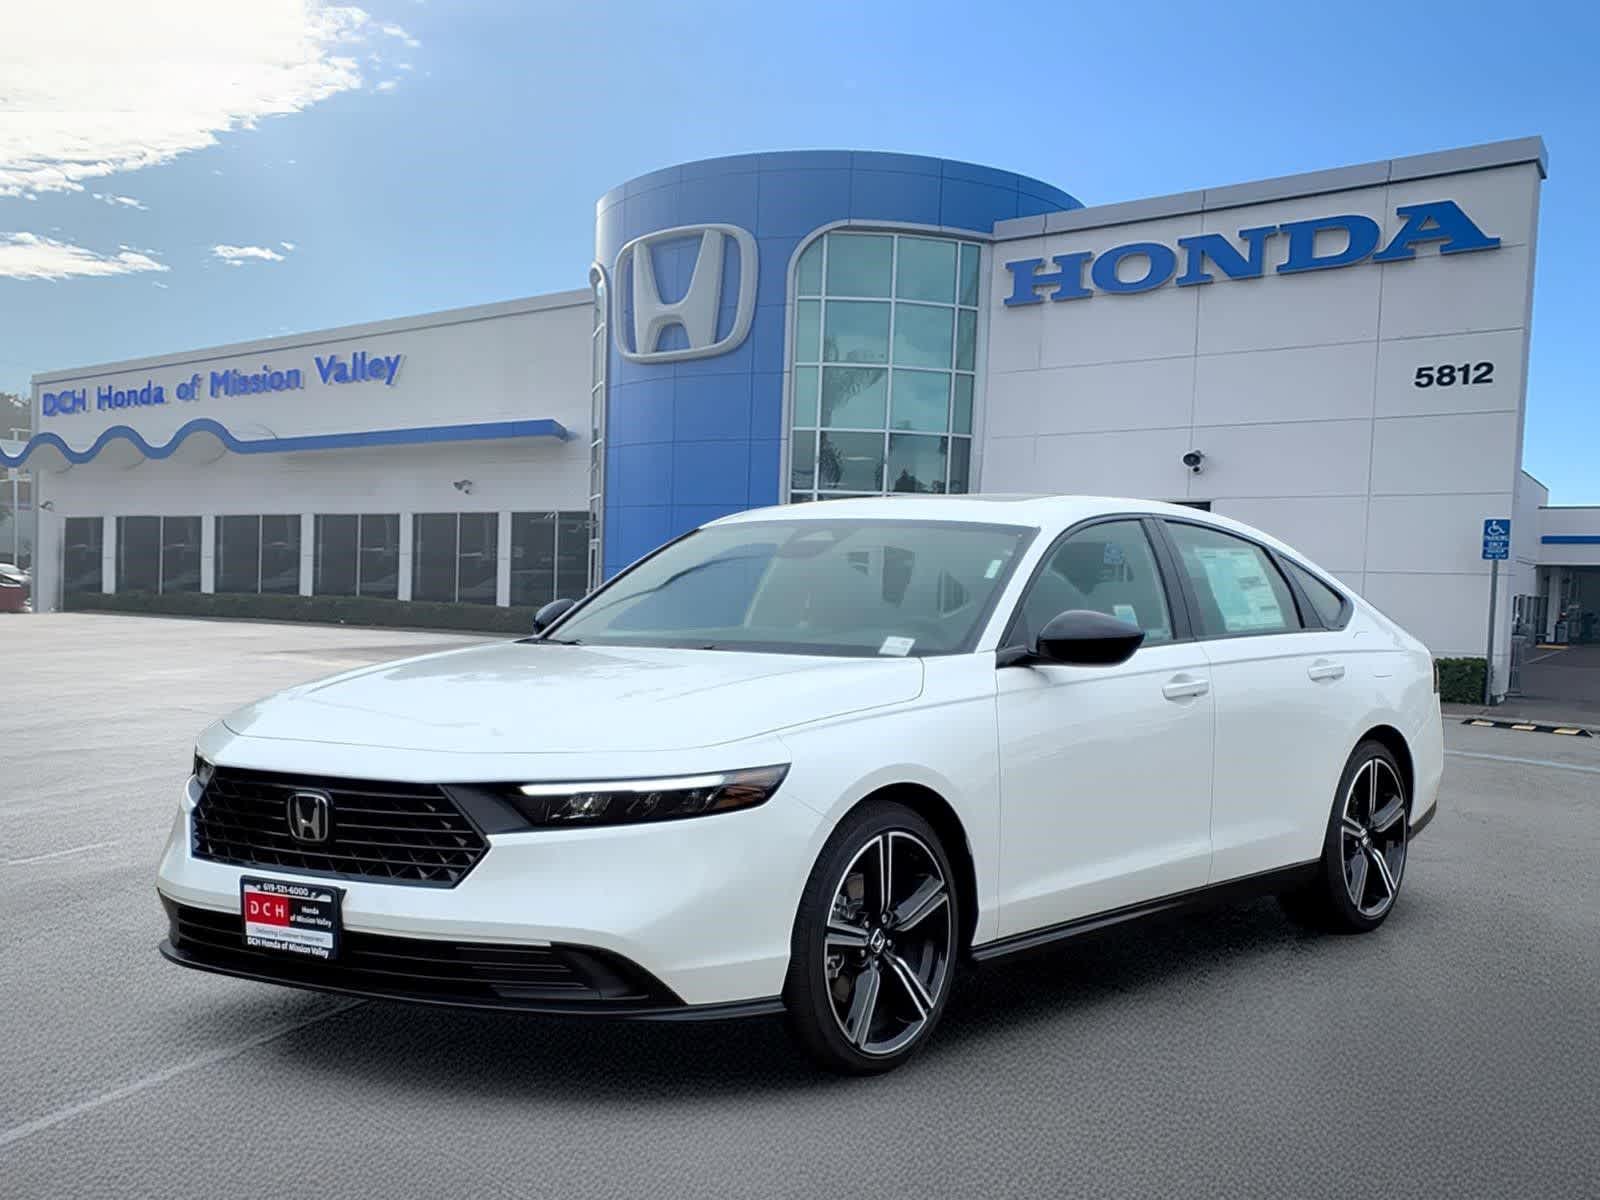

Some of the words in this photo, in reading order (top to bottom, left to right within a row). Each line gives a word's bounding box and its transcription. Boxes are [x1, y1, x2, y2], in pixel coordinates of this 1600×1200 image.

[1003, 199, 1500, 306] HONDA
[42, 388, 87, 417] DCH
[97, 379, 165, 411] Honda
[176, 372, 203, 401] of
[209, 364, 303, 398] Mission
[314, 351, 402, 386] Valley
[1413, 361, 1495, 388] 5812
[262, 938, 280, 949] Honda
